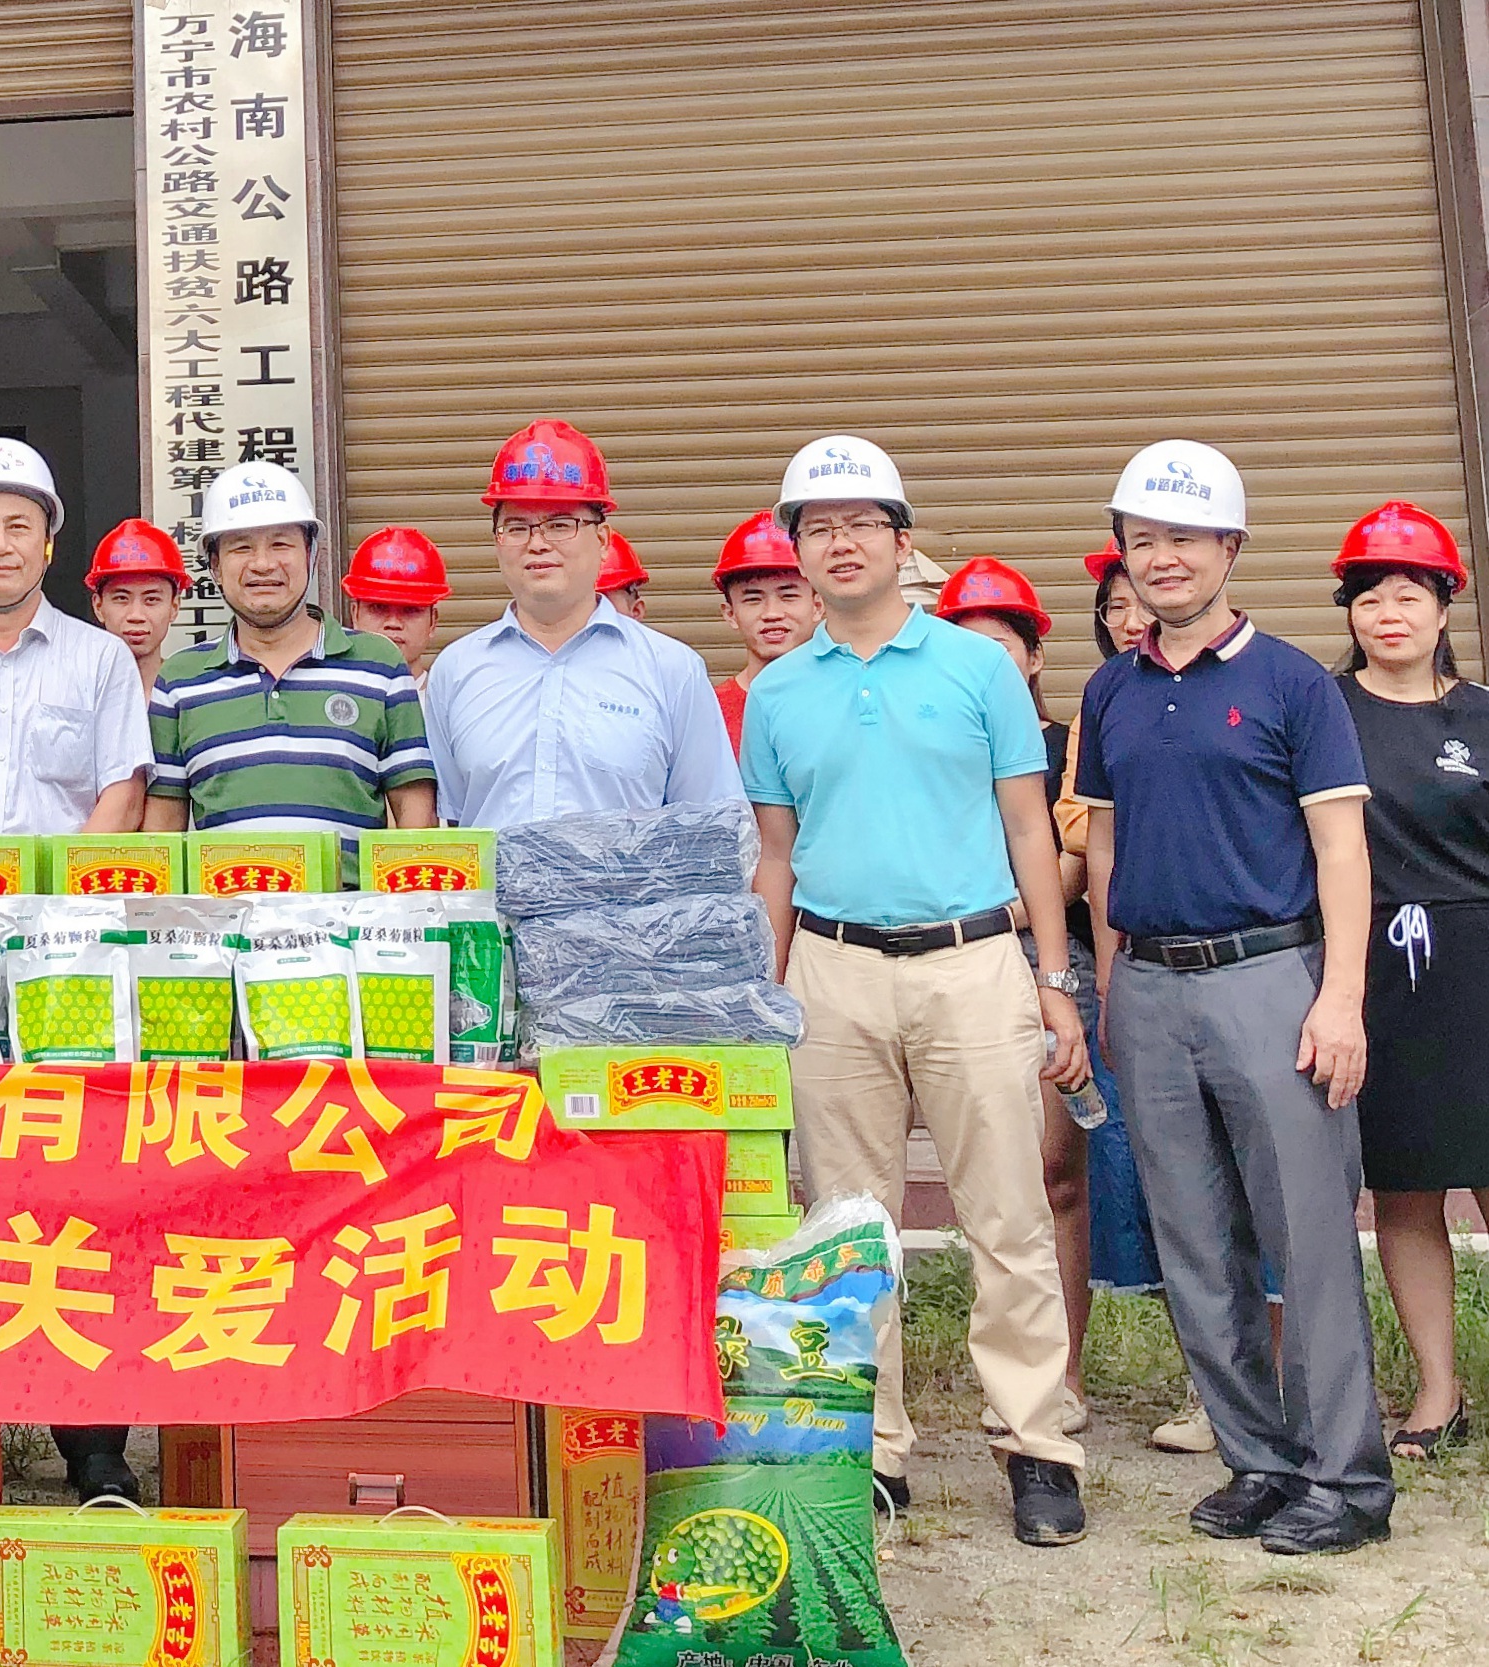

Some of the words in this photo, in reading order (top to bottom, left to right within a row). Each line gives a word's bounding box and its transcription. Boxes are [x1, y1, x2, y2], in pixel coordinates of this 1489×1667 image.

[88, 868, 150, 894] 王老吉
[222, 867, 285, 892] 王老吉
[395, 866, 458, 892] 王老吉
[25, 929, 98, 949] 夏桑菊颗粒
[149, 929, 221, 946] 夏桑菊颗粒
[252, 931, 330, 952] 夏桑菊颗粒
[361, 926, 424, 943] 夏桑菊颗粒
[632, 1067, 699, 1093] 王老吉
[723, 1397, 770, 1436] ung
[783, 1397, 848, 1431] Bean
[163, 1571, 195, 1651] 王老吉
[476, 1579, 507, 1660] 王老吉
